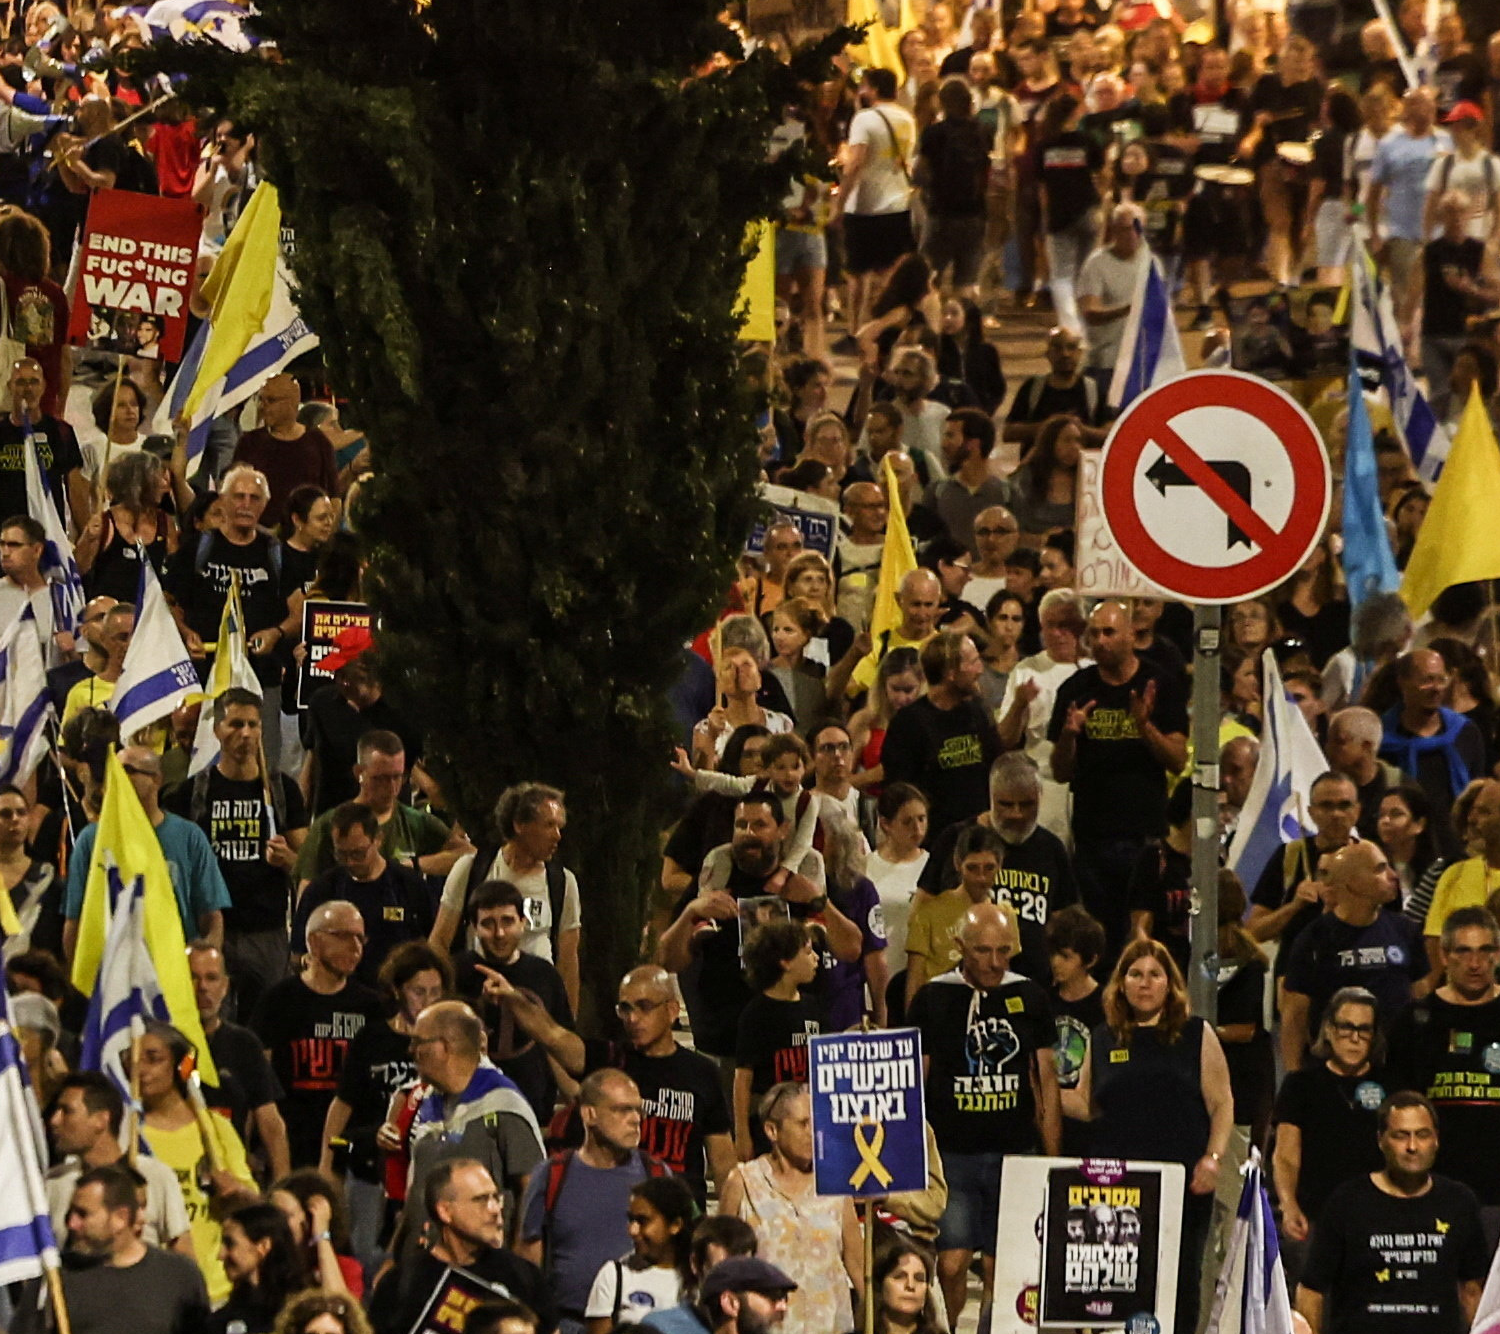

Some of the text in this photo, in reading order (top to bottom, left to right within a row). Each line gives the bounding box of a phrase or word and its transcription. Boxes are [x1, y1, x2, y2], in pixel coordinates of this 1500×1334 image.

[88, 233, 193, 266] END THIS
[82, 275, 185, 319] WAR
[210, 819, 261, 840] עדיין
[817, 1040, 913, 1063] עד שכולם יהיו
[817, 1058, 916, 1093] חופשיים
[953, 1074, 1020, 1094] חובה
[830, 1093, 907, 1124] בארצנו
[1068, 1186, 1141, 1208] מסרבים
[1065, 1241, 1139, 1263] למלחמה
[1064, 1261, 1138, 1284] שלהם
